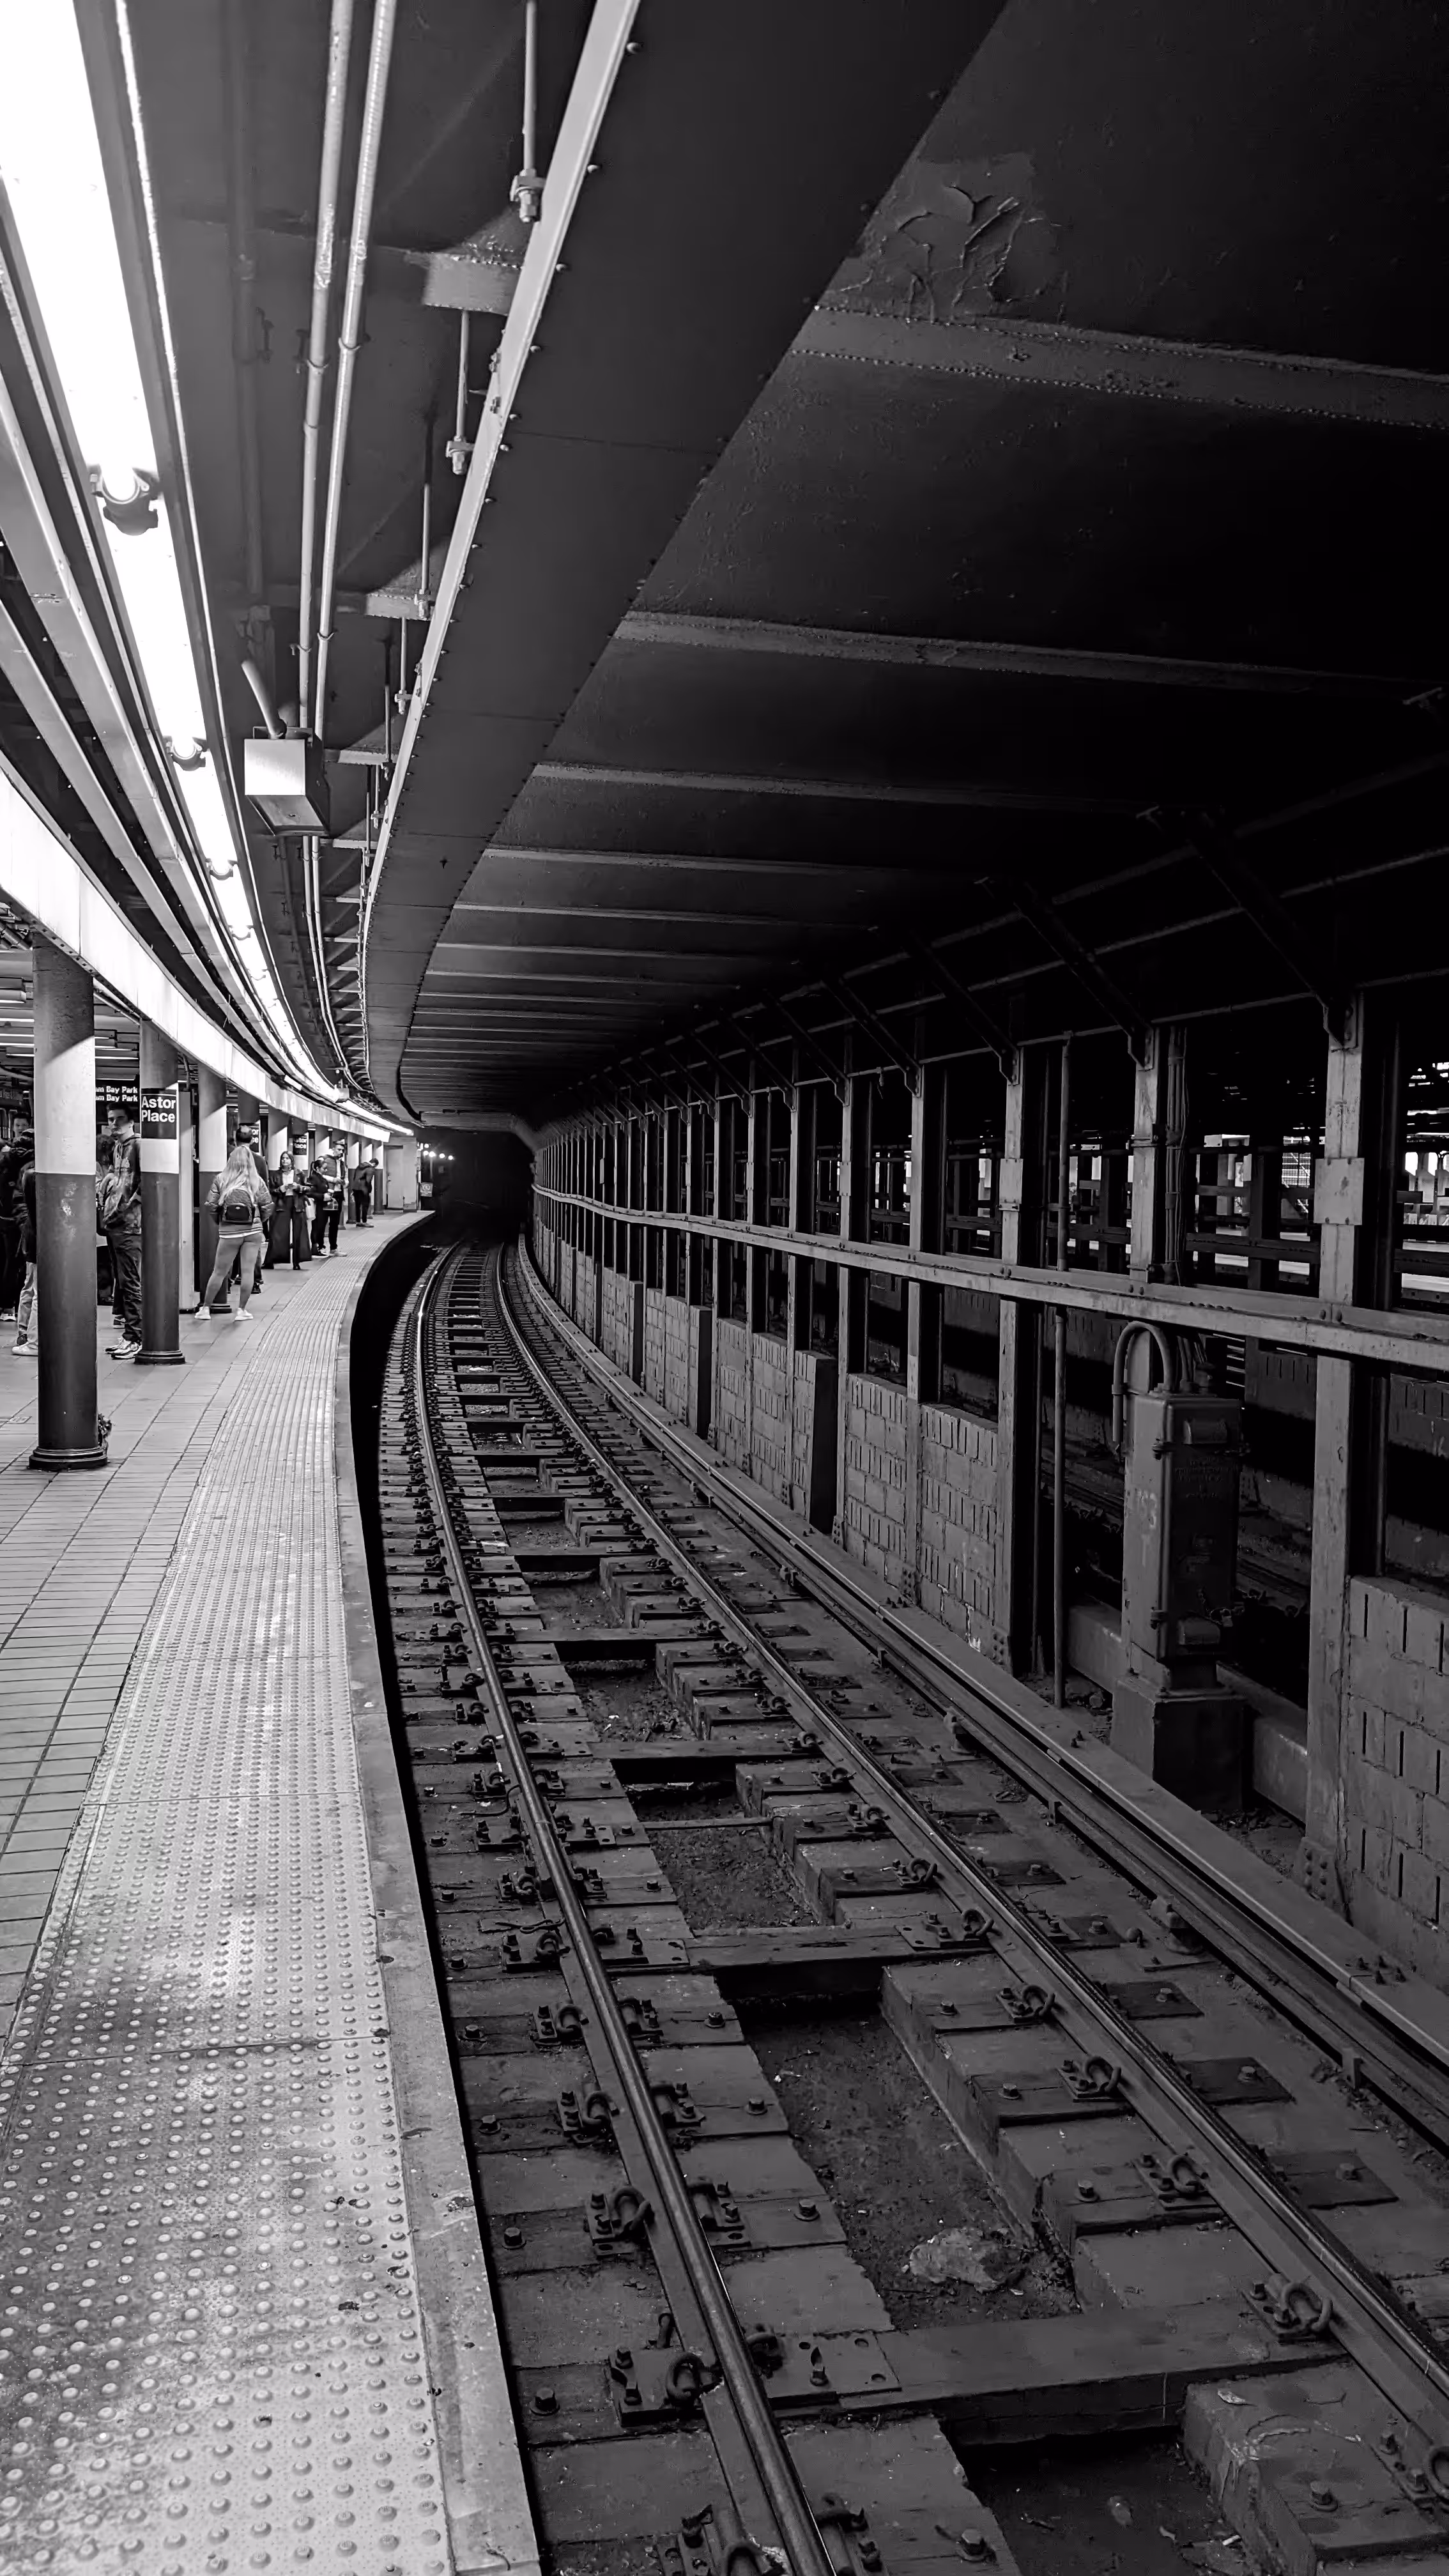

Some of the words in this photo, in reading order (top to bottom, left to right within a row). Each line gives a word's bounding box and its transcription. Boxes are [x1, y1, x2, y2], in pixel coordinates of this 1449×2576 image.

[106, 1085, 120, 1094] Bay
[106, 1094, 120, 1102] Bay
[141, 1096, 176, 1108] Astor
[141, 1110, 175, 1123] Place
